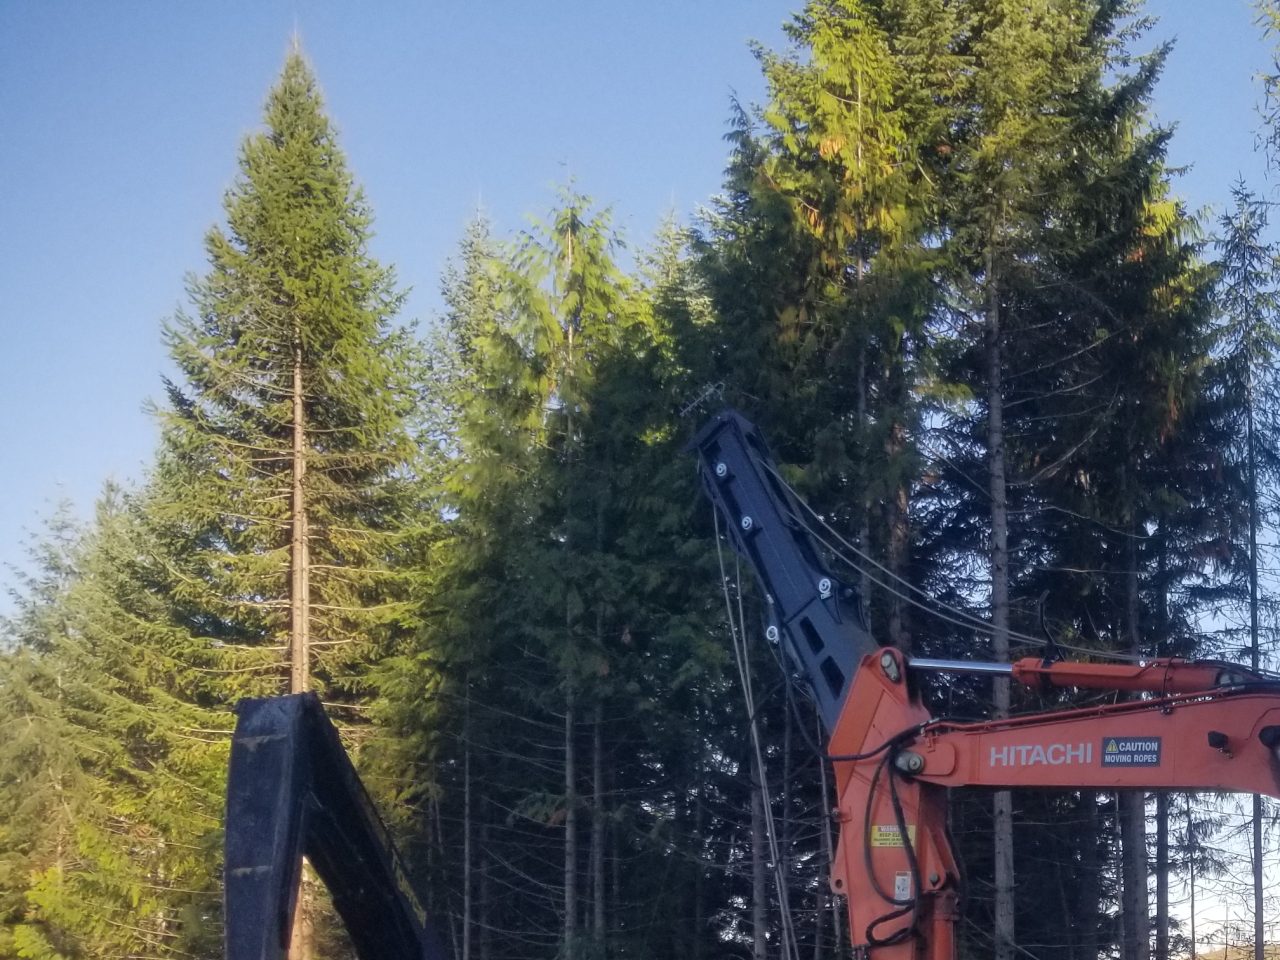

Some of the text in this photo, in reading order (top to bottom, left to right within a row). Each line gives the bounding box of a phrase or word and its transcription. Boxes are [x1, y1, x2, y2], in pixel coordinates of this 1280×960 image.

[1119, 742, 1158, 752] CAUTION
[990, 743, 1092, 767] HITACHI
[1104, 754, 1157, 763] MOVING ROPES
